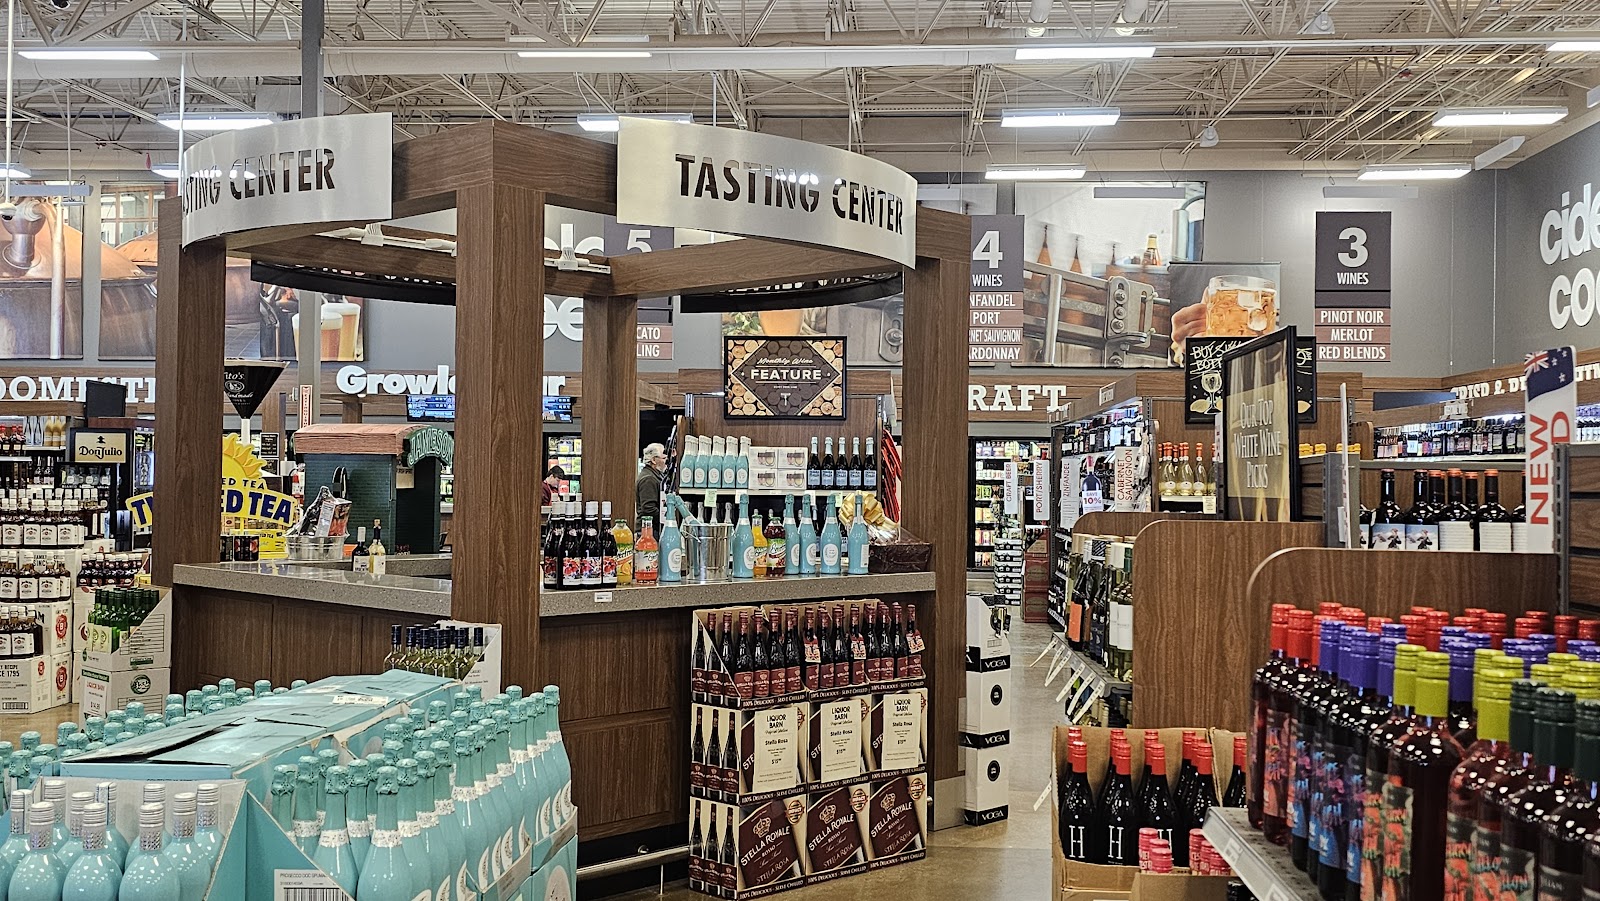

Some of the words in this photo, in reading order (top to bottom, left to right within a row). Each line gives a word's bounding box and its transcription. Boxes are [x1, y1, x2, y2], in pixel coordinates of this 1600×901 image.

[229, 148, 335, 200] CENTER
[675, 153, 819, 213] TASTING
[832, 178, 903, 235] CENTER
[627, 229, 652, 253] 5
[972, 231, 1003, 269] 4
[1338, 227, 1369, 268] 3
[972, 274, 1003, 287] WINES
[1337, 272, 1369, 285] WINES
[1549, 267, 1600, 330] co
[973, 311, 1000, 325] PORT
[1321, 311, 1354, 323] PINOT
[1357, 311, 1384, 324] NOIR
[984, 329, 1021, 342] SAUVIGNON
[1331, 328, 1374, 342] MERLOT
[1319, 346, 1341, 359] RED
[1344, 346, 1386, 360] BLENDS
[336, 365, 455, 396] Growl
[750, 369, 822, 380] FEATURE
[0, 376, 156, 403] OMETI
[968, 384, 1067, 412] RAFT
[1117, 459, 1125, 500] CABERNET
[1125, 449, 1133, 500] SAUVIGNON
[1530, 413, 1549, 525] NEW
[250, 491, 292, 525] TEA
[985, 659, 1007, 669] VOGA
[767, 714, 786, 722] LIQUOR
[831, 706, 850, 714] LIQUOR
[985, 734, 1006, 744] VOGA
[871, 814, 892, 838] STELLA
[891, 802, 913, 819] ROYALE
[981, 811, 1004, 821] VOGA
[809, 827, 831, 851] STELLA
[831, 814, 854, 832] ROYALE
[1069, 825, 1085, 858] H
[1108, 825, 1124, 859] H
[741, 840, 766, 867] STELLA
[765, 826, 790, 845] ROYALE
